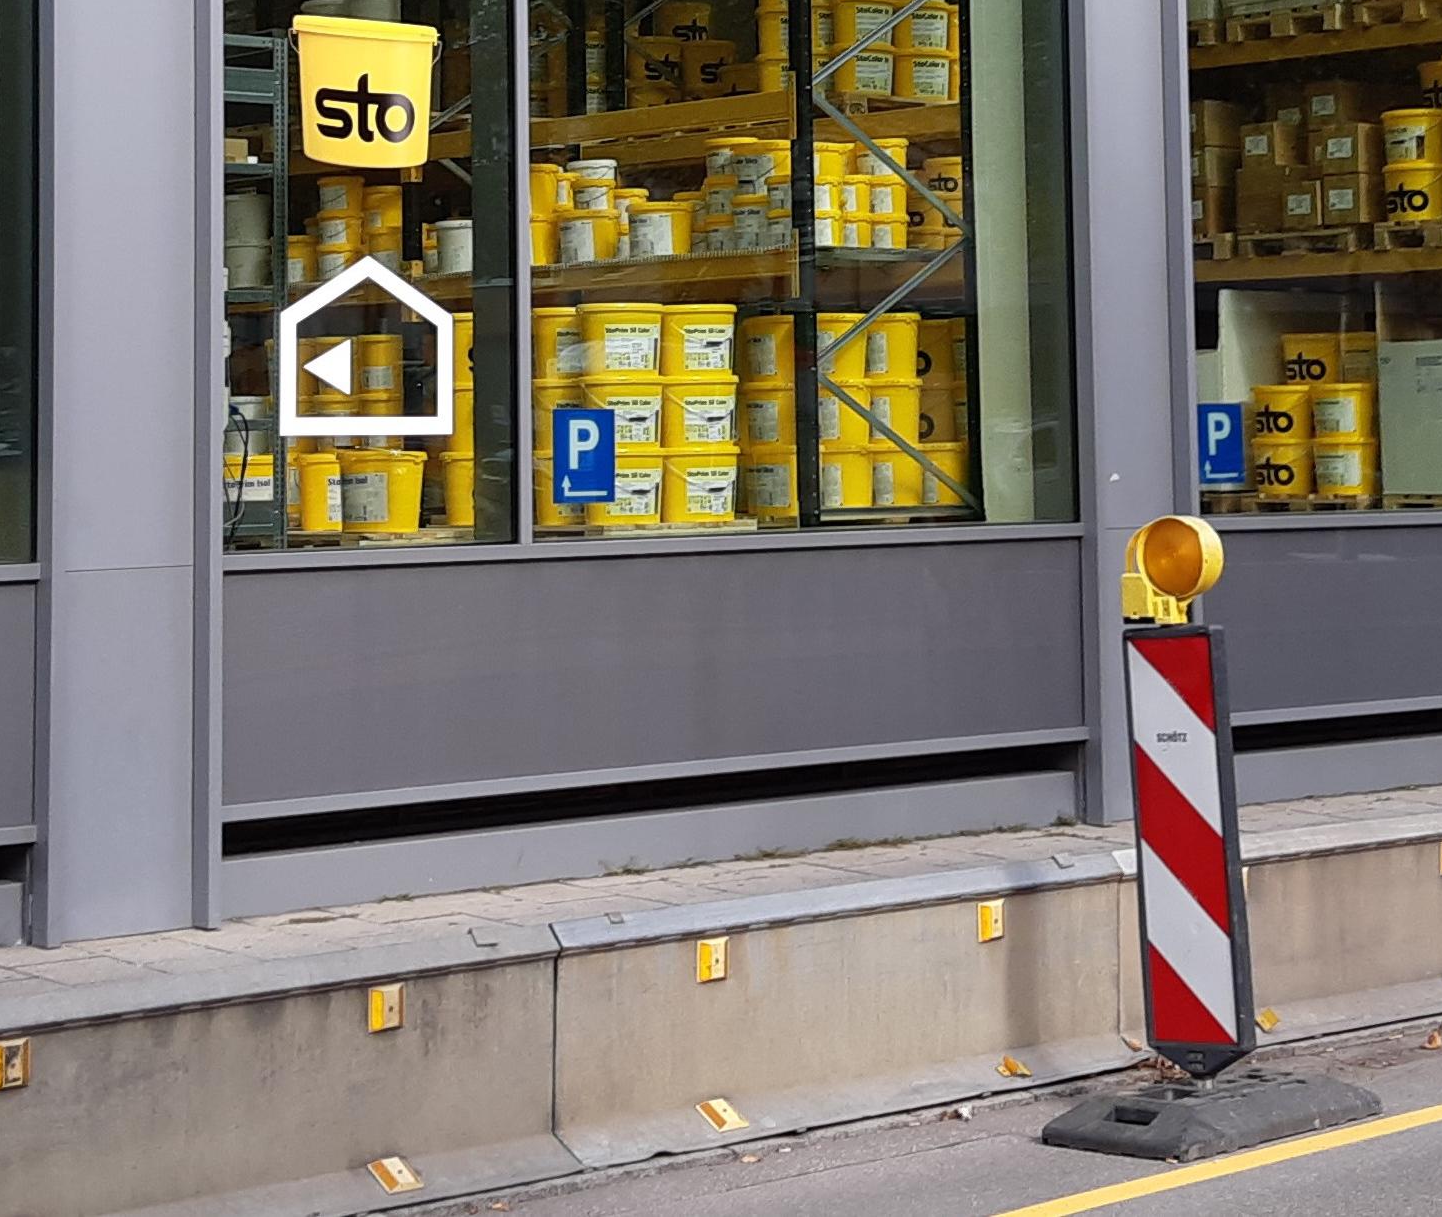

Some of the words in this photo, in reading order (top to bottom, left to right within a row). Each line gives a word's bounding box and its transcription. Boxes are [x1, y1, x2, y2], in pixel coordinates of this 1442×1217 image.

[314, 73, 415, 144] sto
[569, 419, 600, 470] P
[1208, 412, 1231, 456] P
